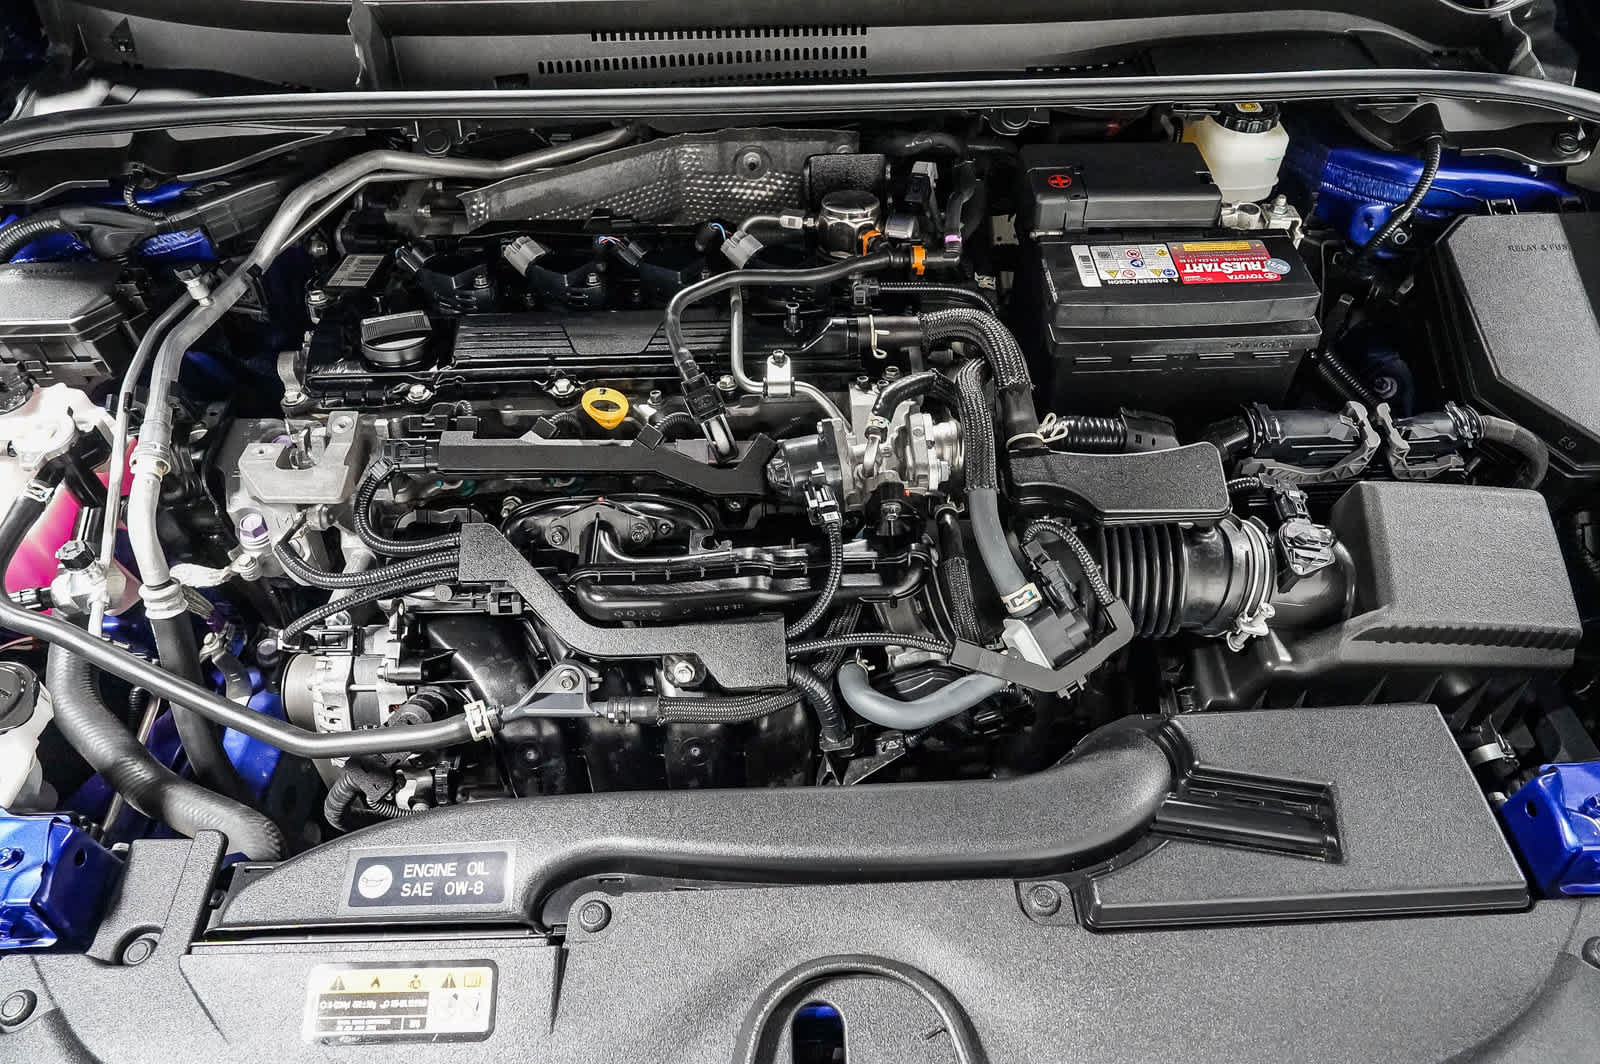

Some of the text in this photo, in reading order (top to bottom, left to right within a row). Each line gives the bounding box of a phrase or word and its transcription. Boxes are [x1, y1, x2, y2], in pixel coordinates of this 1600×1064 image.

[1508, 244, 1537, 252] RELAY
[1227, 273, 1264, 281] TOYOTA
[403, 860, 489, 879] ENGINE OIL
[400, 880, 484, 897] SAE 0W-8
